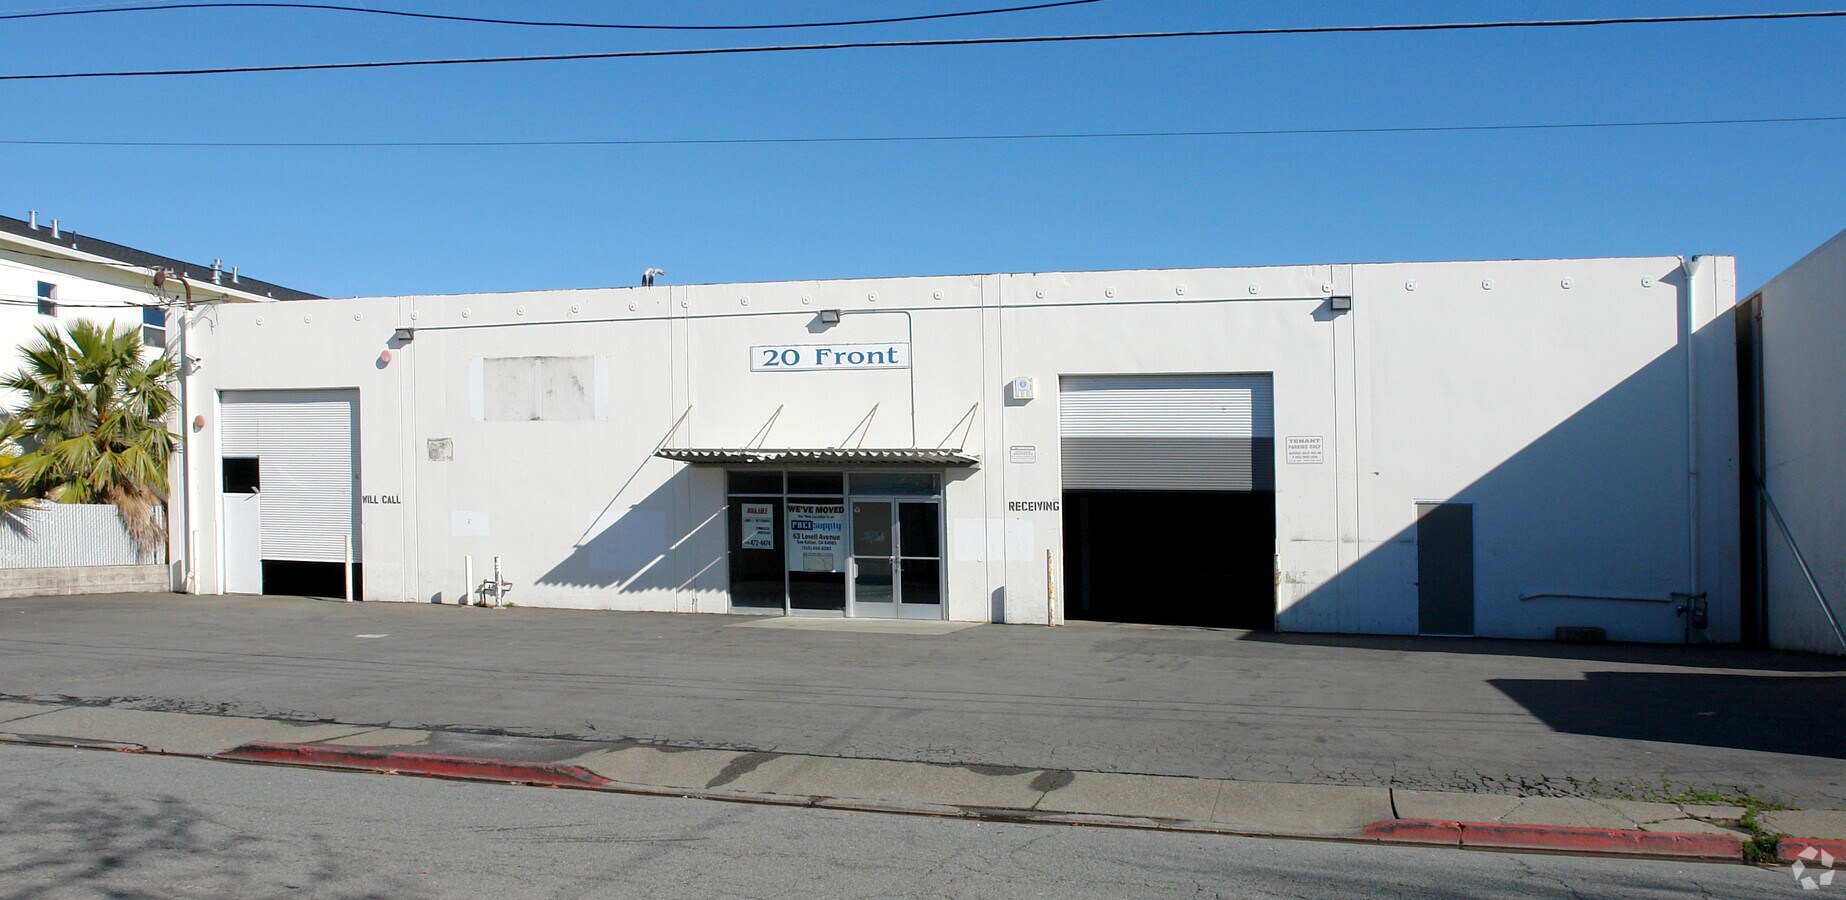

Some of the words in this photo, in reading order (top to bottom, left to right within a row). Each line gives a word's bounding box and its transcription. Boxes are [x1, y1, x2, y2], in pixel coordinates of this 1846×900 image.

[762, 349, 801, 367] 20
[815, 346, 899, 366] Front
[362, 495, 378, 504] WILL
[382, 495, 401, 504] CALL
[787, 505, 814, 514] WE'VE
[815, 506, 844, 514] MOVED
[1008, 501, 1059, 511] RECEIVING
[792, 520, 813, 530] PACE
[813, 522, 842, 531] supply
